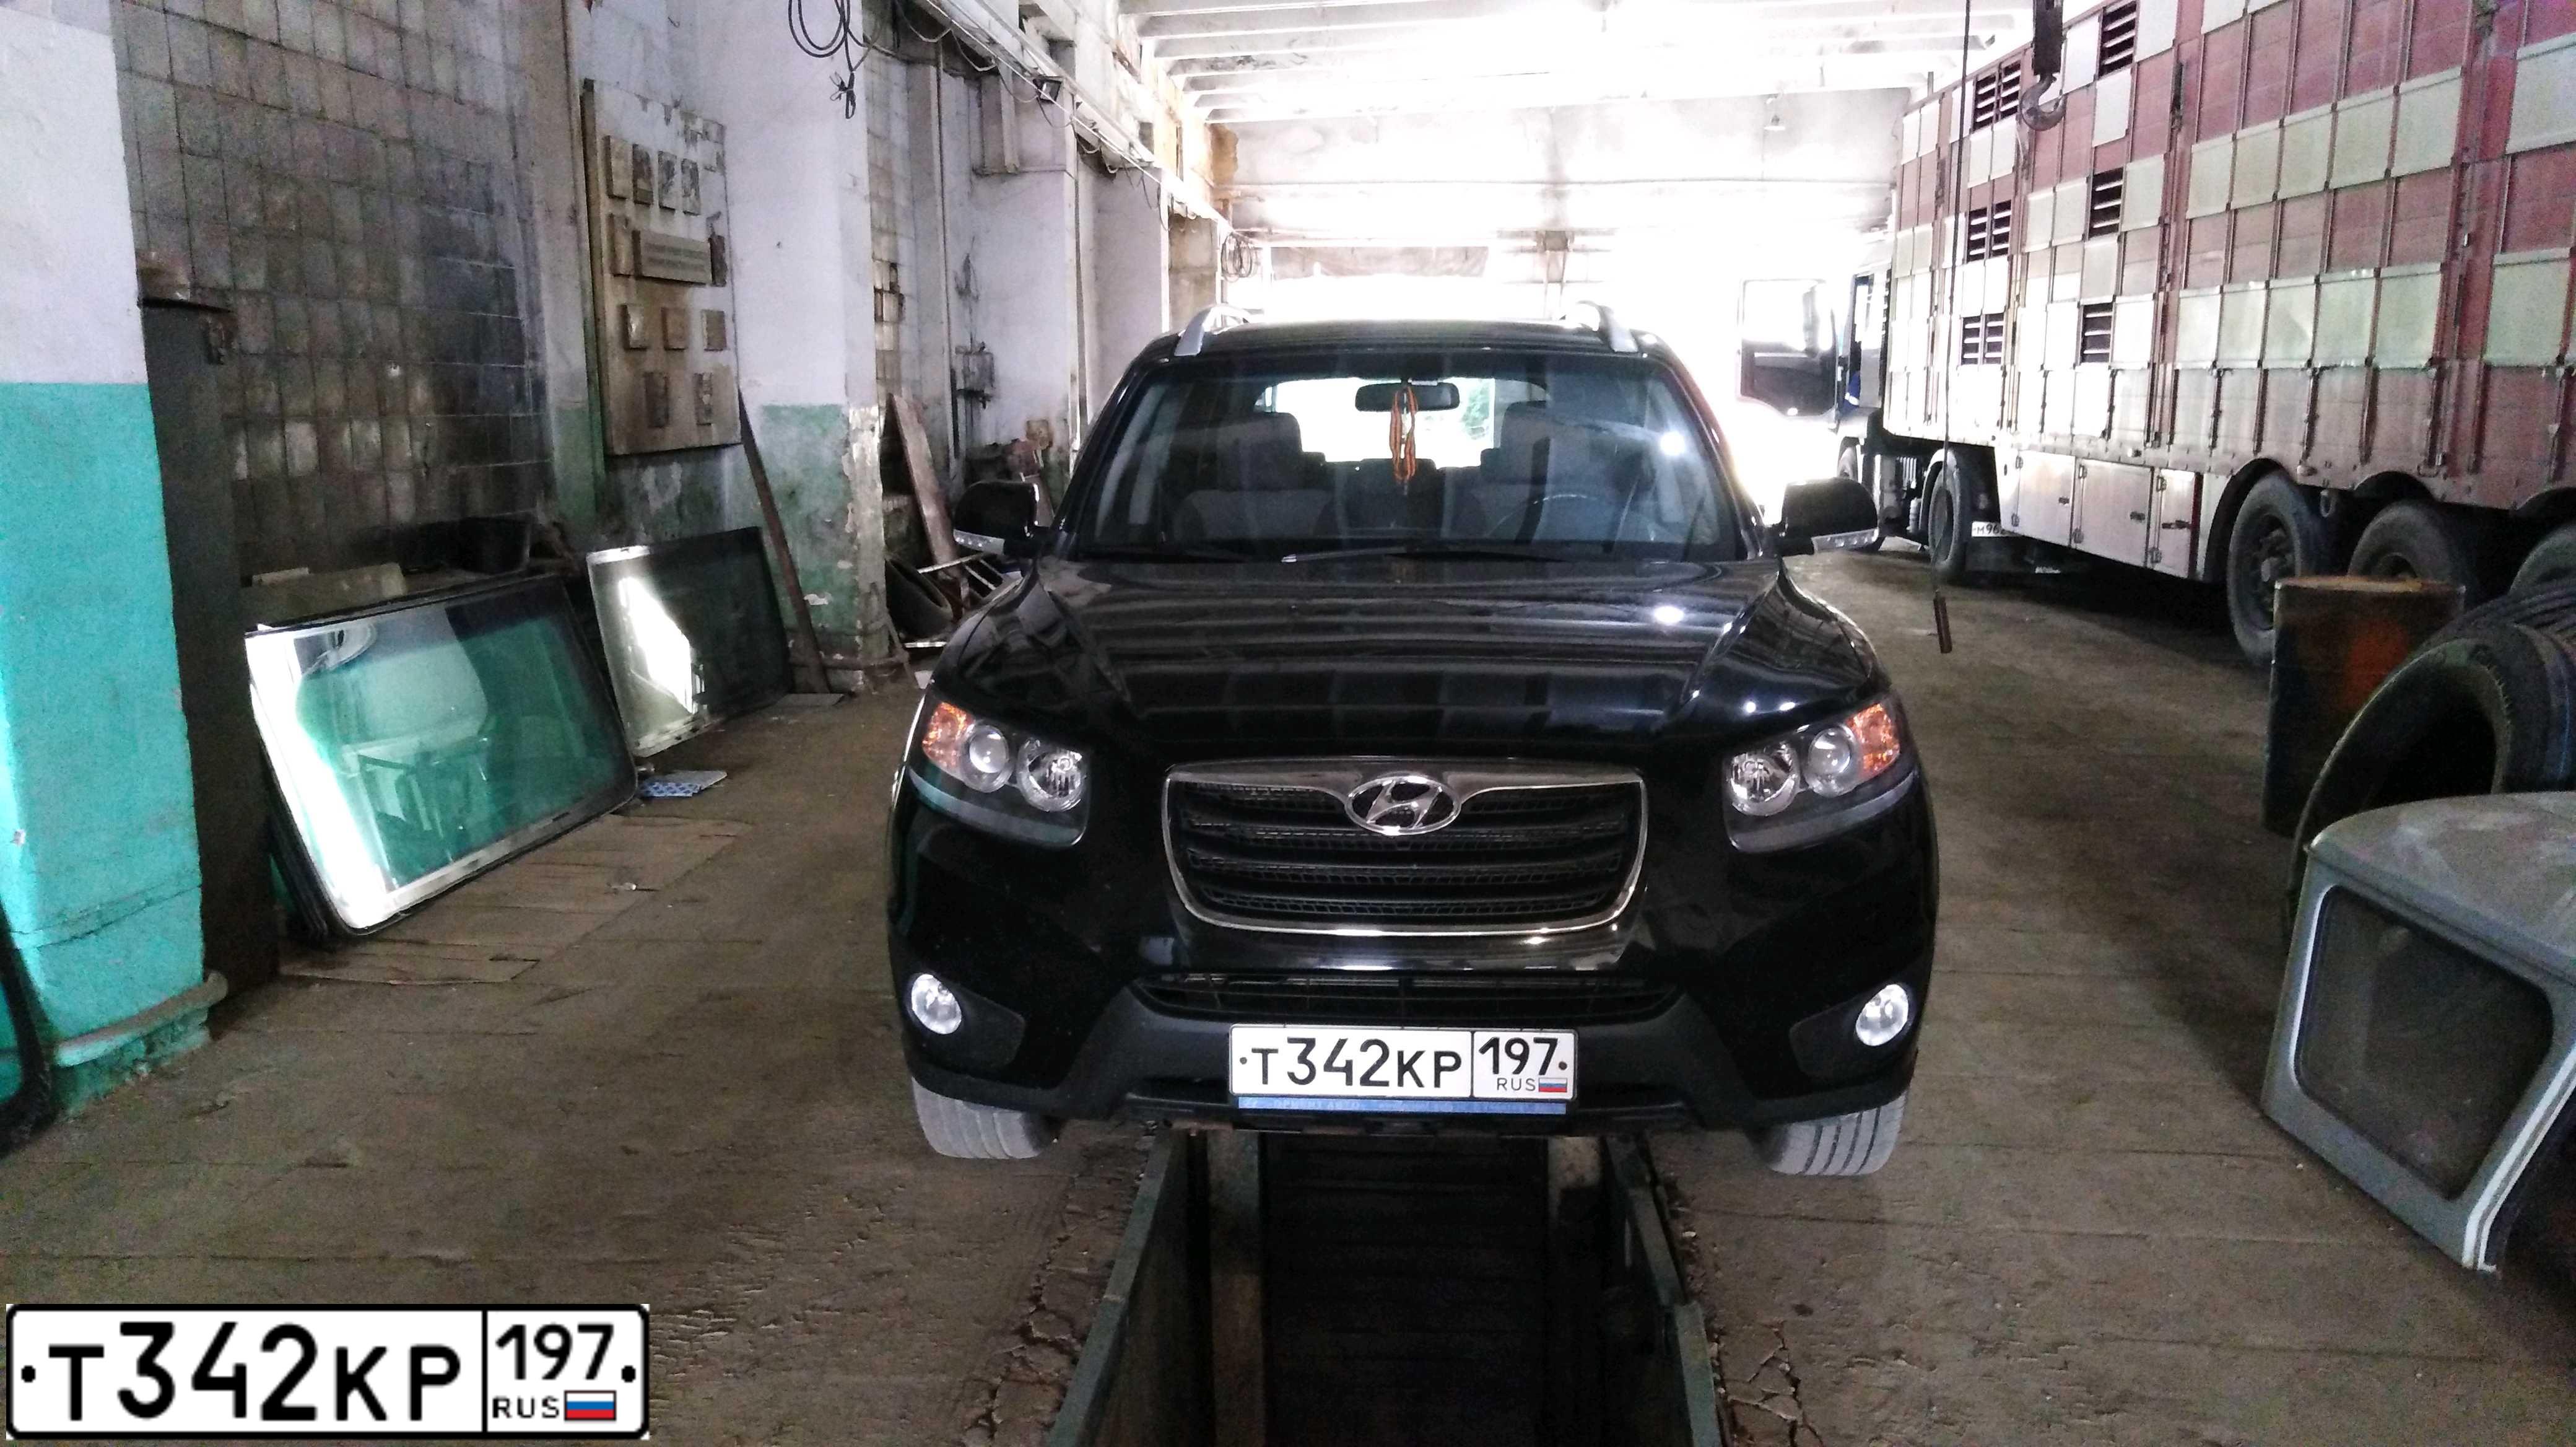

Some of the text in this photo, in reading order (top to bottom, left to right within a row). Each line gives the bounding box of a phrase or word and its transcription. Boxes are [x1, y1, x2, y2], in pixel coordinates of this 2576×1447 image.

[1251, 1036, 1559, 1088] Т342КР 197
[1497, 1077, 1536, 1091] RUS
